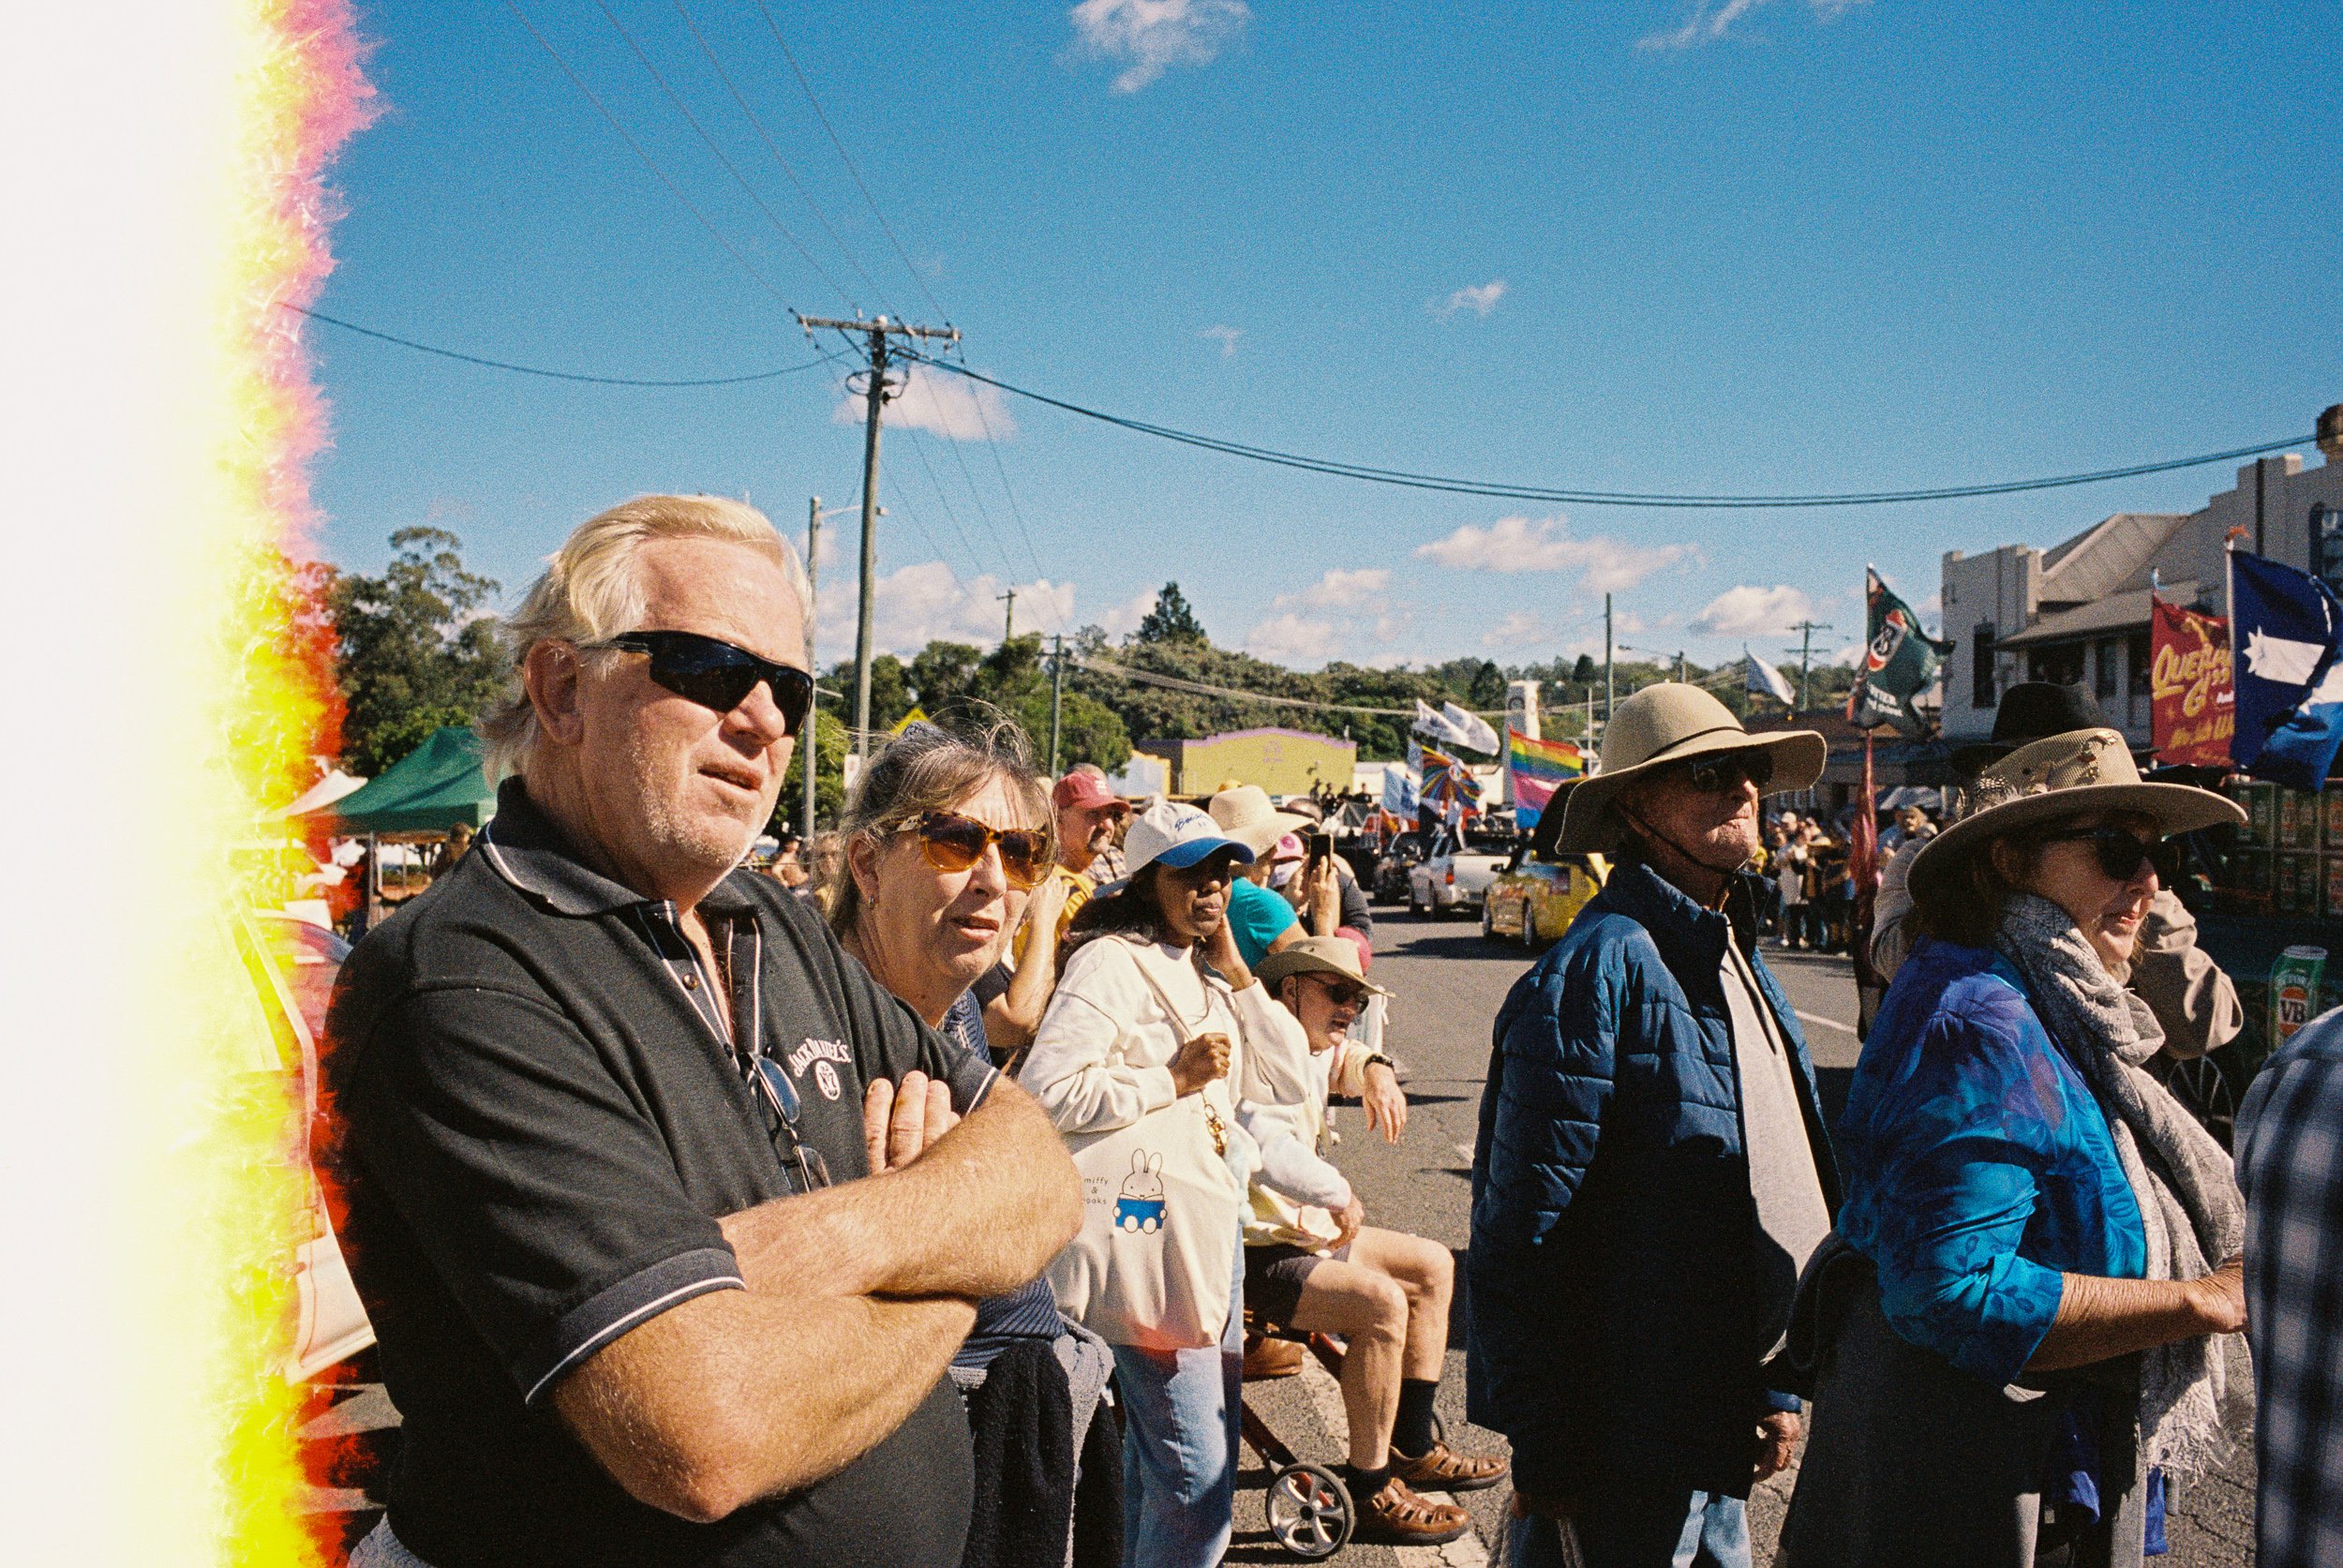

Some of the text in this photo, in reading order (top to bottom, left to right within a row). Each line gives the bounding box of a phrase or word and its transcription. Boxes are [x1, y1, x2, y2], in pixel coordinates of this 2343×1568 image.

[2279, 999, 2306, 1023] VB
[788, 1042, 813, 1078] JACK
[1083, 1176, 1109, 1186] miffy
[1091, 1186, 1098, 1194] &
